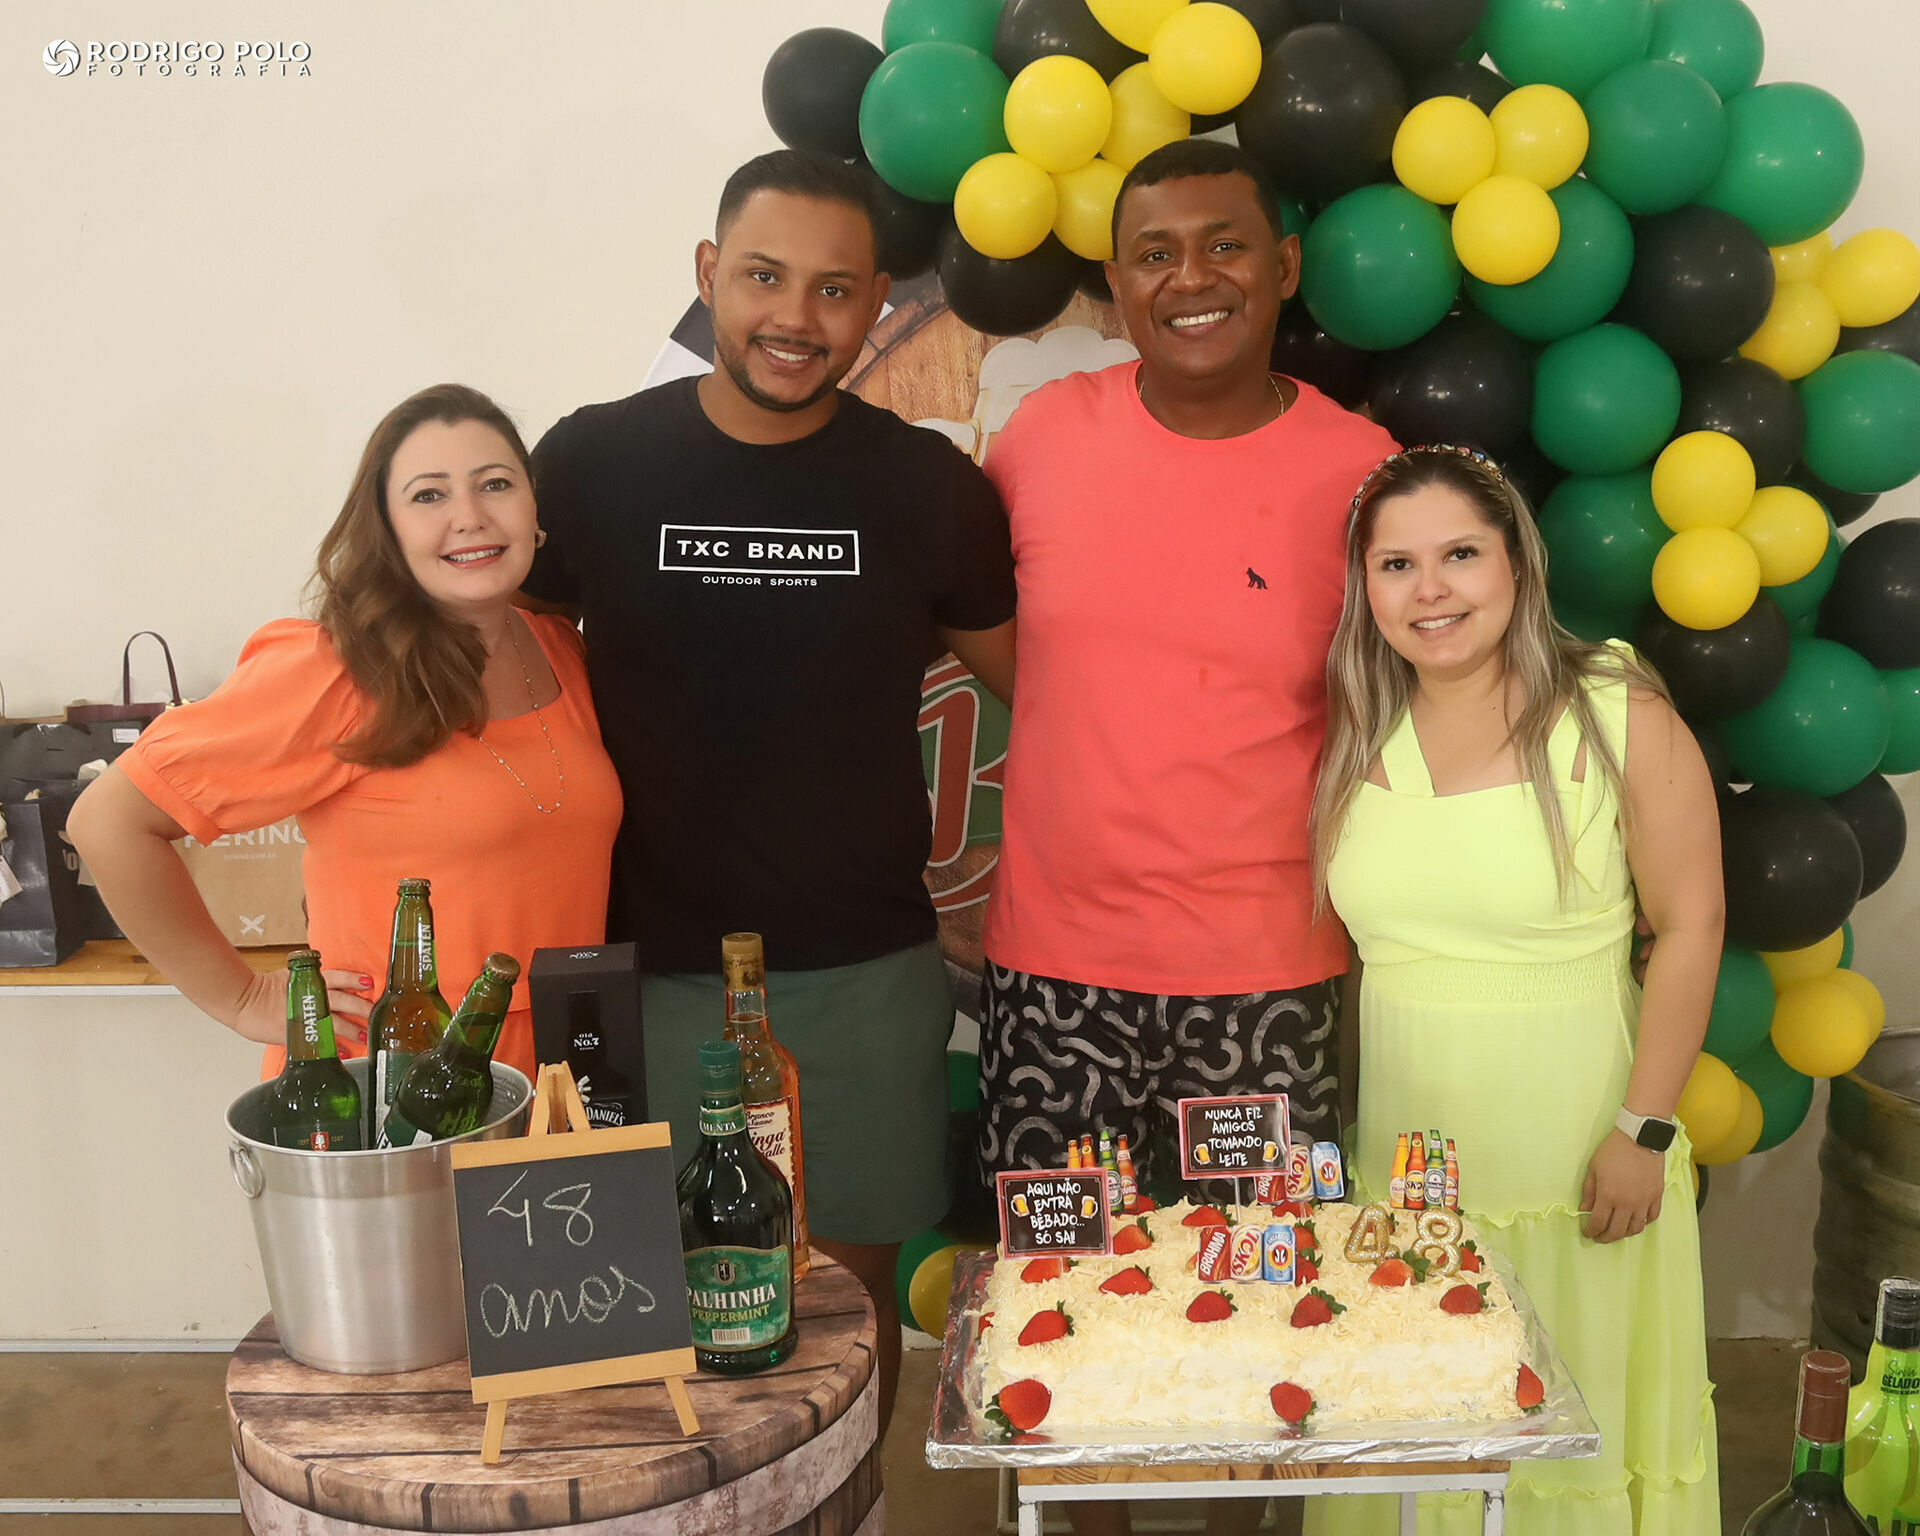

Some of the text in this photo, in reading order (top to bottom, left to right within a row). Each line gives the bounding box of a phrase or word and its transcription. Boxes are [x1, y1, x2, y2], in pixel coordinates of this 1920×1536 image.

[676, 539, 844, 560] TXC BRAND
[702, 575, 818, 587] OUTDOOR SPORTS
[184, 823, 307, 848] ERIN
[421, 923, 433, 972] SPATEN
[302, 994, 319, 1043] SPATEN
[573, 1037, 600, 1048] No.7
[1205, 1106, 1264, 1122] NUNCA FIZ
[703, 1121, 737, 1132] MENTA
[1211, 1120, 1257, 1135] AMIGOS
[751, 1130, 785, 1152] inga
[763, 1143, 785, 1157] alle
[1207, 1135, 1263, 1151] TOMANDO
[1218, 1152, 1249, 1168] LEITE
[1286, 1153, 1308, 1196] SKOL
[1026, 1177, 1082, 1197] AQUI NÃO
[1257, 1175, 1274, 1198] BRA
[1405, 1180, 1426, 1191] SKO
[487, 1169, 594, 1247] 48
[1033, 1195, 1074, 1214] ENTRA
[1029, 1212, 1085, 1231] BÊBADO...
[1034, 1230, 1052, 1245] SÓ
[1200, 1231, 1227, 1277] BRAHMA
[1231, 1231, 1260, 1276] SKOL
[480, 1265, 656, 1338] anos
[686, 1282, 777, 1310] PALHINHA
[692, 1303, 771, 1323] PEPPERMINT
[1882, 1373, 1920, 1389] GELADO
